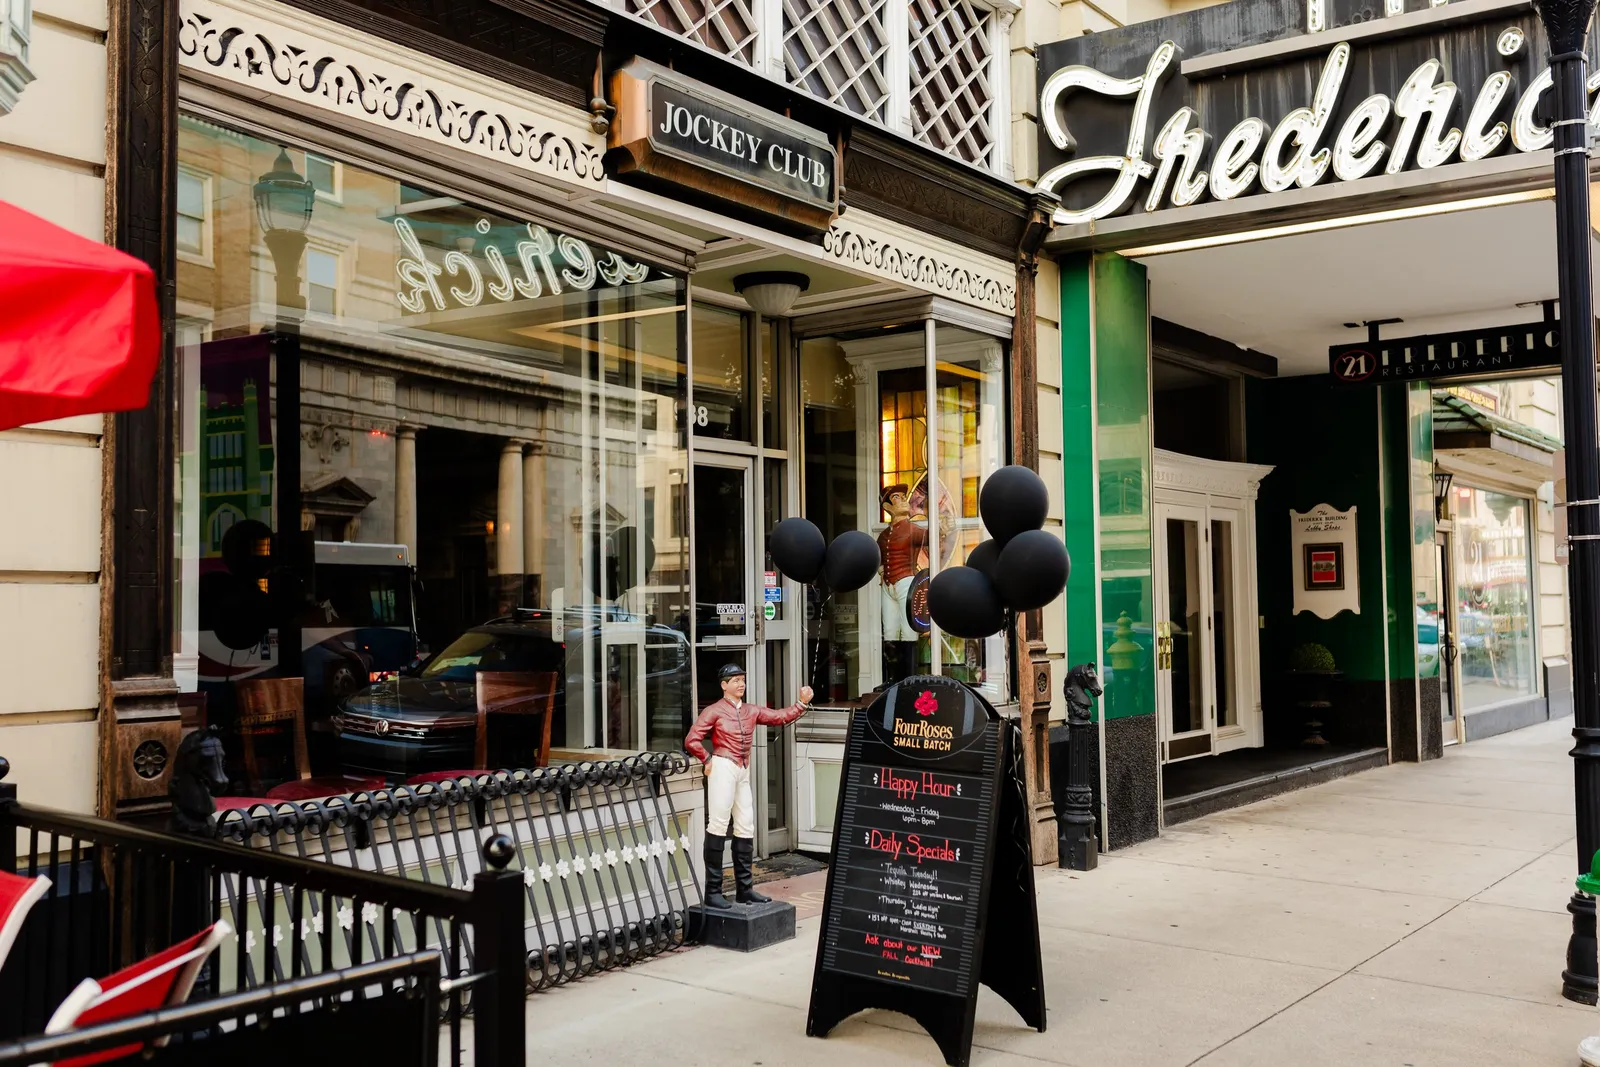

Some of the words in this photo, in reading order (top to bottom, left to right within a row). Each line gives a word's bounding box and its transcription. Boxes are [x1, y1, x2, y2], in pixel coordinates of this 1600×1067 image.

[1036, 27, 1600, 225] Frederic
[660, 101, 762, 164] JOCKEY
[768, 144, 825, 188] CLUB
[1343, 354, 1367, 378] 21
[1383, 354, 1513, 377] RESTAURANT
[894, 737, 921, 749] SMALL
[923, 739, 951, 751] BATCH
[881, 768, 918, 800] Happy
[922, 772, 956, 797] Hour
[882, 803, 915, 816] Wednesday
[920, 806, 940, 819] Friday
[870, 829, 902, 860] Daily
[906, 834, 955, 864] Specials
[885, 863, 907, 877] Tequila
[884, 877, 906, 889] Whiskey
[909, 880, 938, 893] Wednesday
[881, 895, 907, 909] Thursday
[865, 932, 879, 945] Ask
[883, 938, 904, 949] about
[921, 945, 941, 956] NEW
[882, 950, 898, 960] FALL
